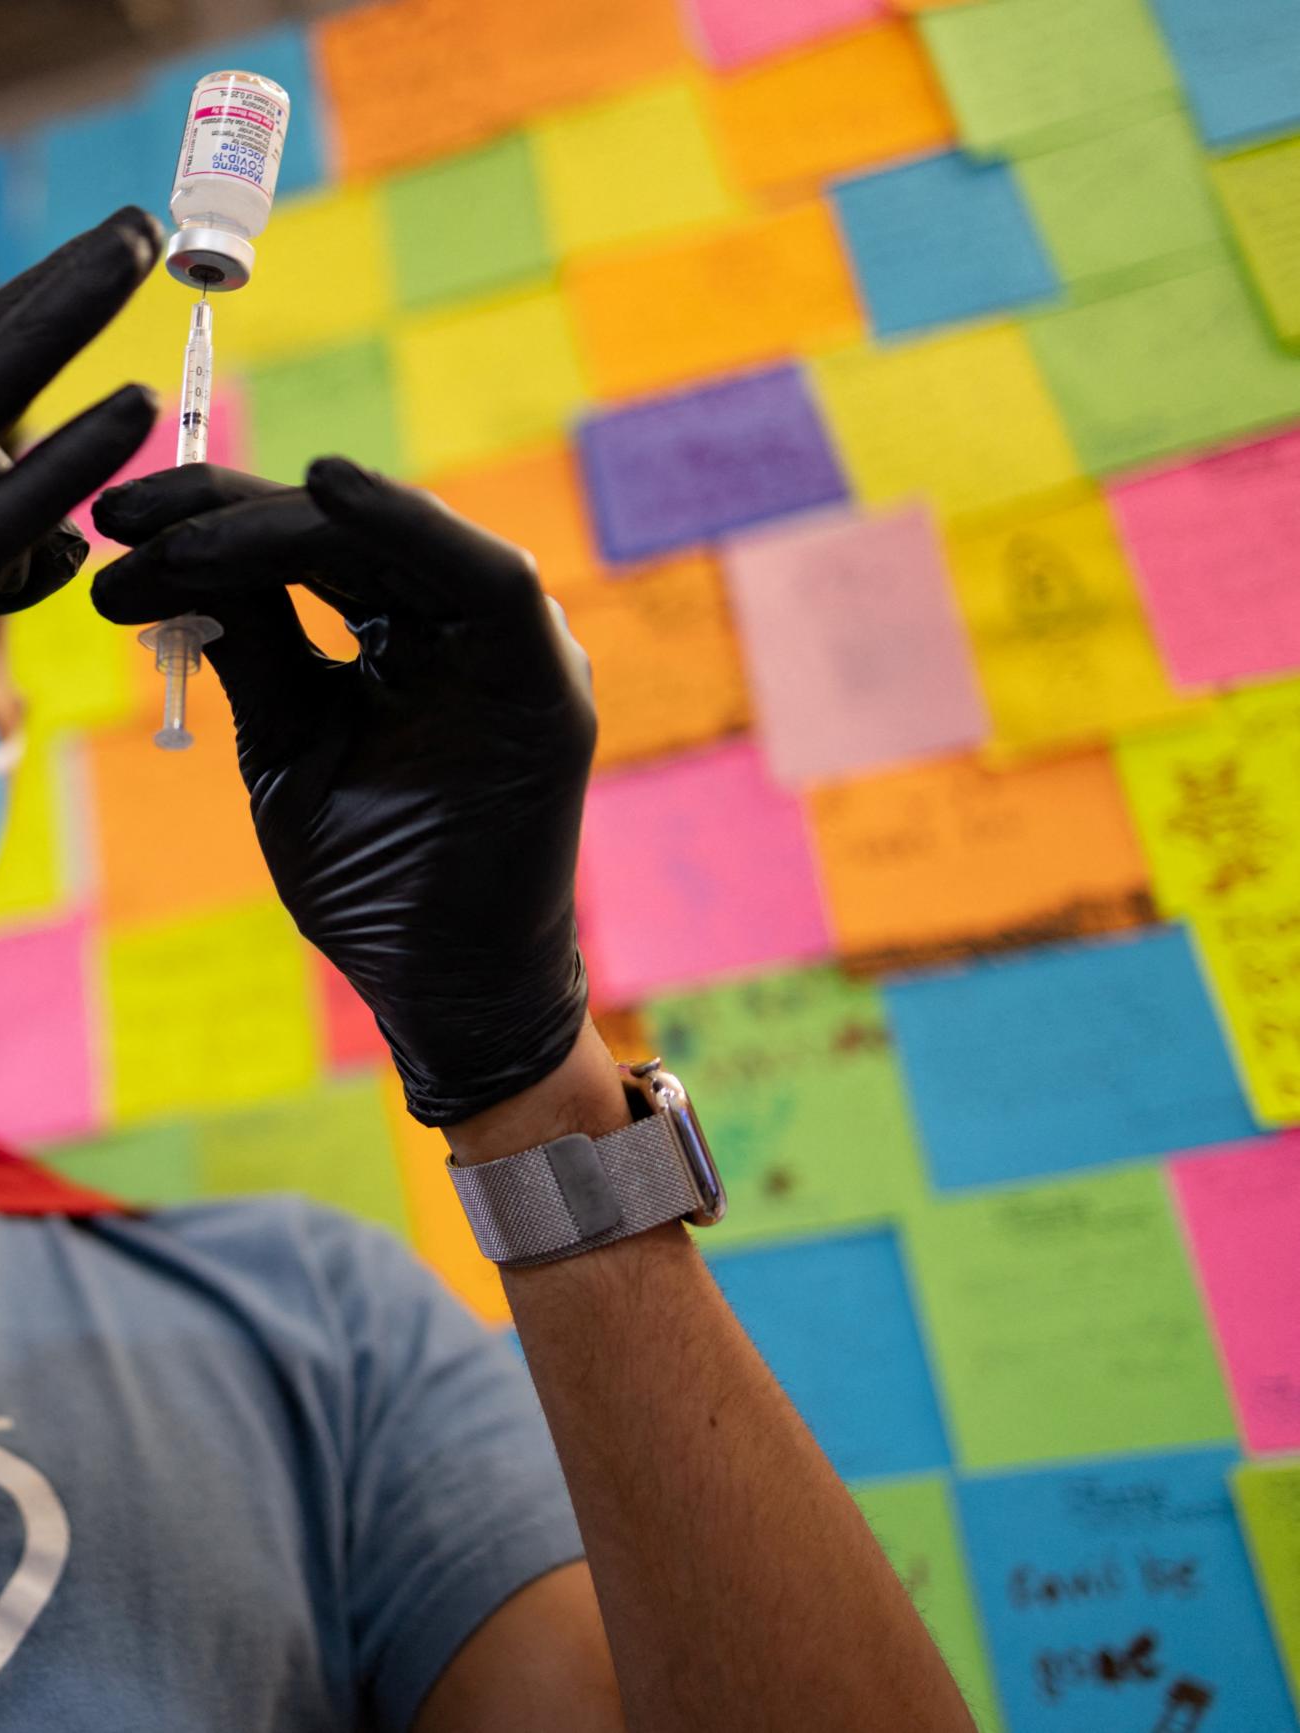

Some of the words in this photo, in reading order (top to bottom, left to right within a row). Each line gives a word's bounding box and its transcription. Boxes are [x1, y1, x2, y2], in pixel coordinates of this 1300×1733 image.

[212, 152, 264, 175] COVID-19
[221, 142, 265, 166] Vaccine
[212, 161, 263, 184] Moderna
